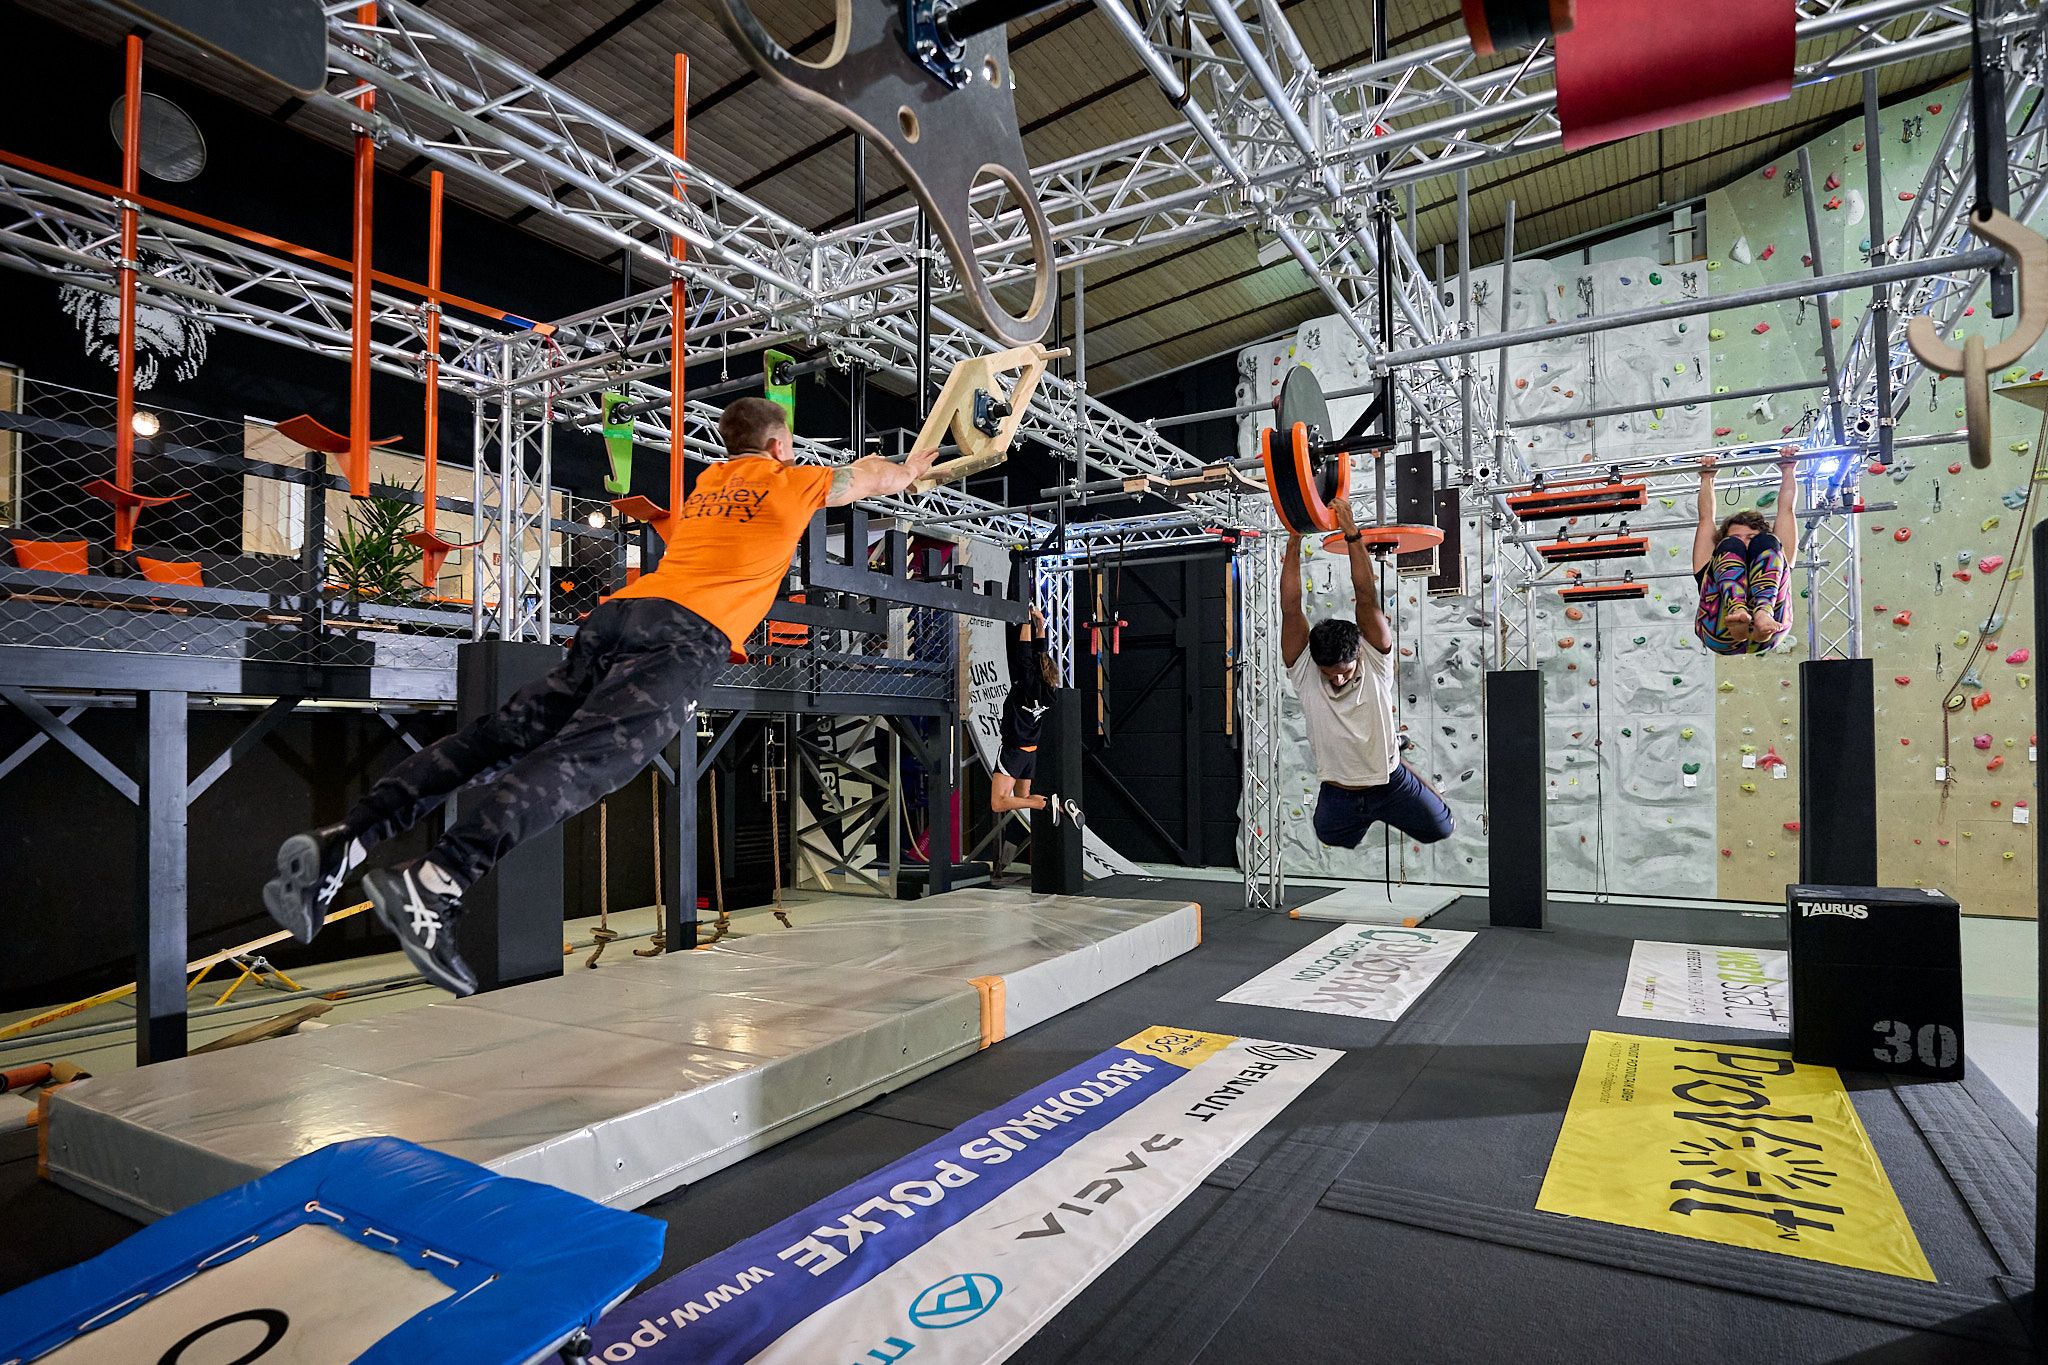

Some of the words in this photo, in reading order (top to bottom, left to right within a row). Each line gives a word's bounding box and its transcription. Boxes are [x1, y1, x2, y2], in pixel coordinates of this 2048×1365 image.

[686, 485, 769, 507] onkey
[682, 504, 762, 523] ctory
[970, 661, 998, 687] UNS
[982, 683, 1009, 702] NICHTS
[988, 702, 1000, 715] ZU
[978, 714, 1003, 738] ST
[1797, 902, 1870, 920] TAURUS
[1290, 939, 1371, 983] PRODUCTION
[1872, 1020, 1958, 1068] 30
[1184, 1061, 1279, 1123] RENAULT
[959, 1057, 1155, 1165] AUTOHAUS
[776, 1160, 980, 1277] POLKE
